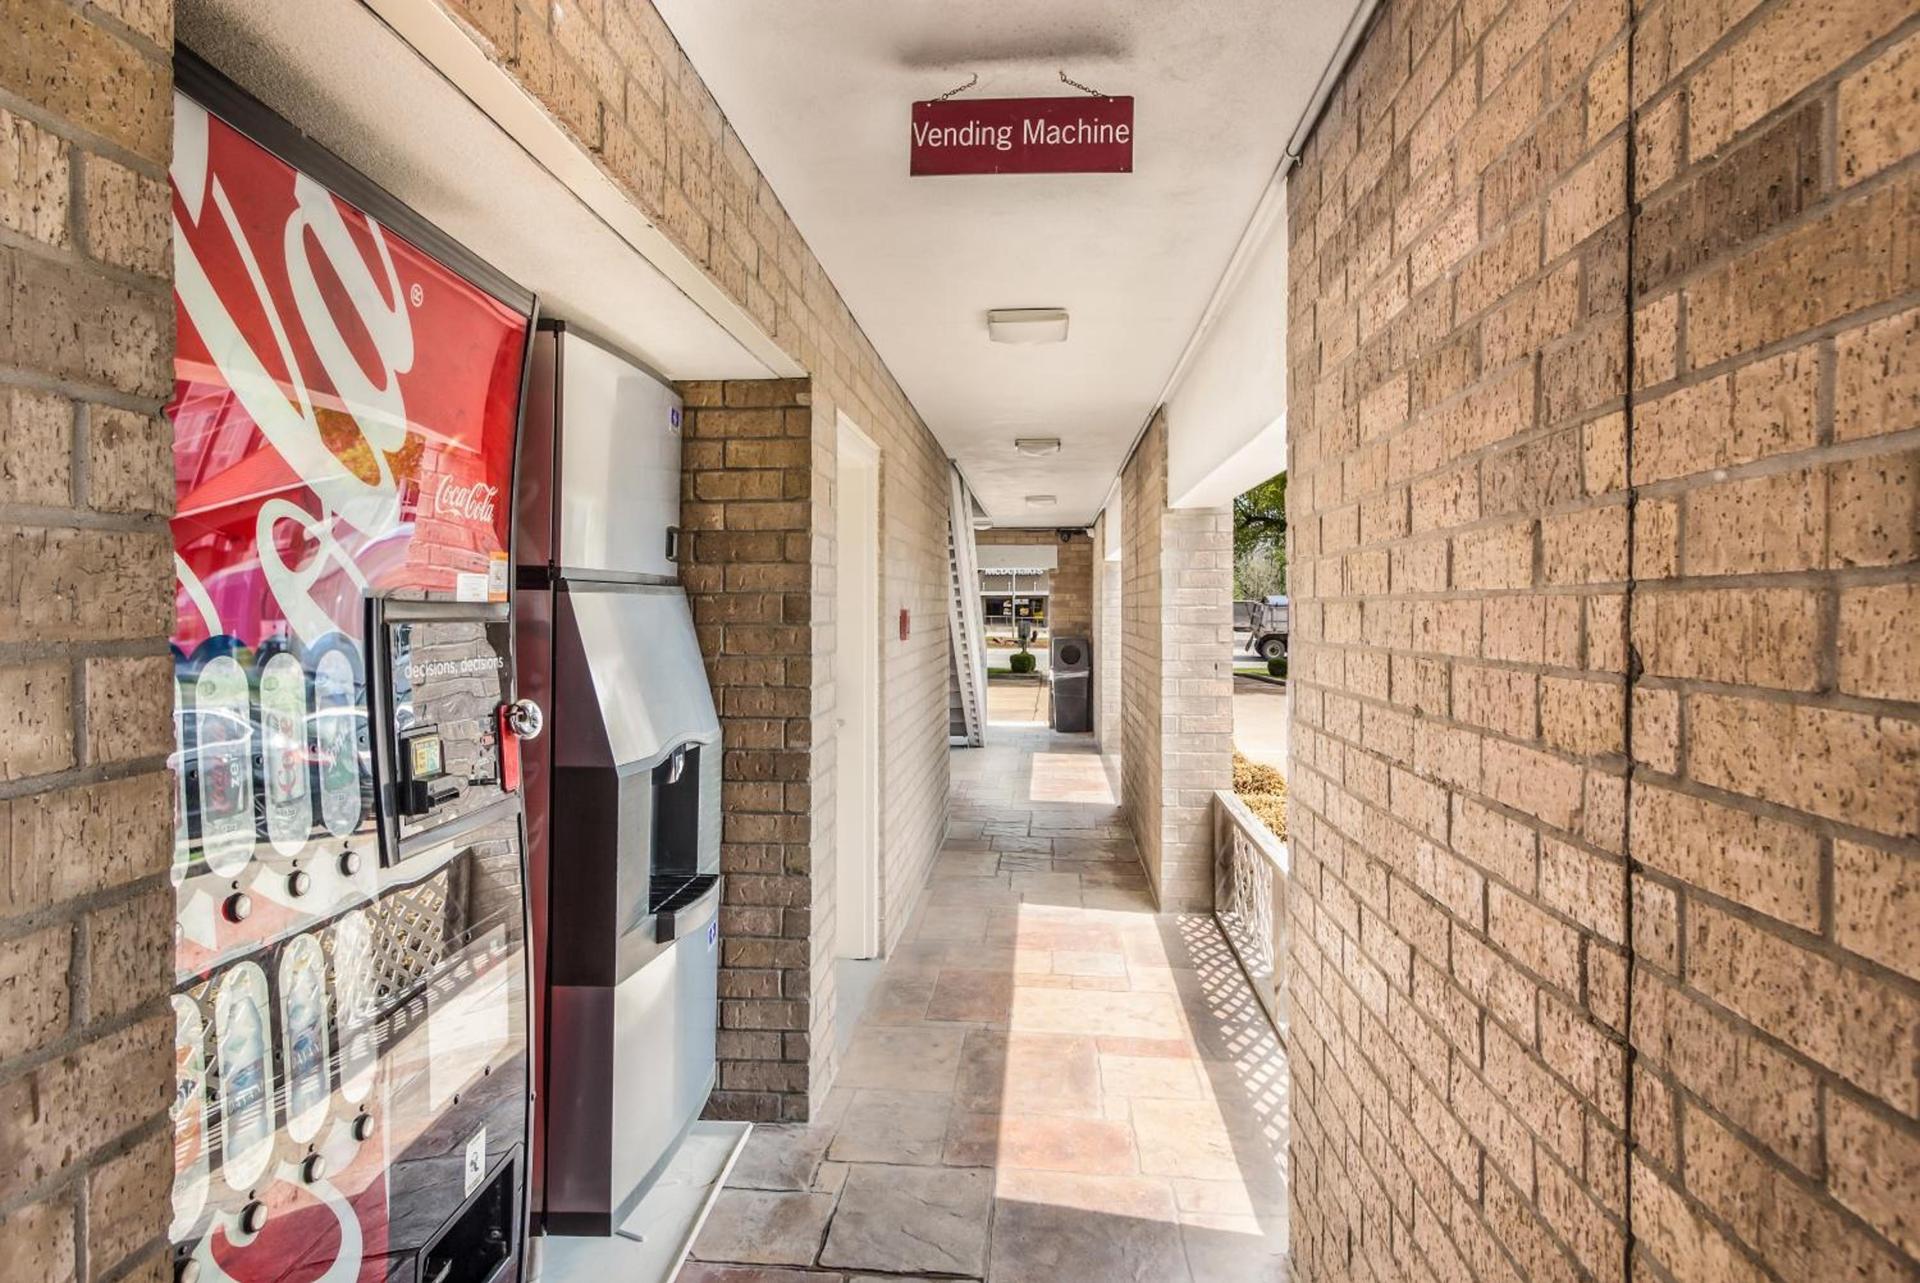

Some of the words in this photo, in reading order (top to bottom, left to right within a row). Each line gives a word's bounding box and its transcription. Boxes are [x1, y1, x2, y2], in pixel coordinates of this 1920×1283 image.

[913, 120, 1013, 150] Vending
[1023, 118, 1129, 145] Machine
[404, 659, 459, 679] decisions,
[460, 655, 504, 672] decisions
